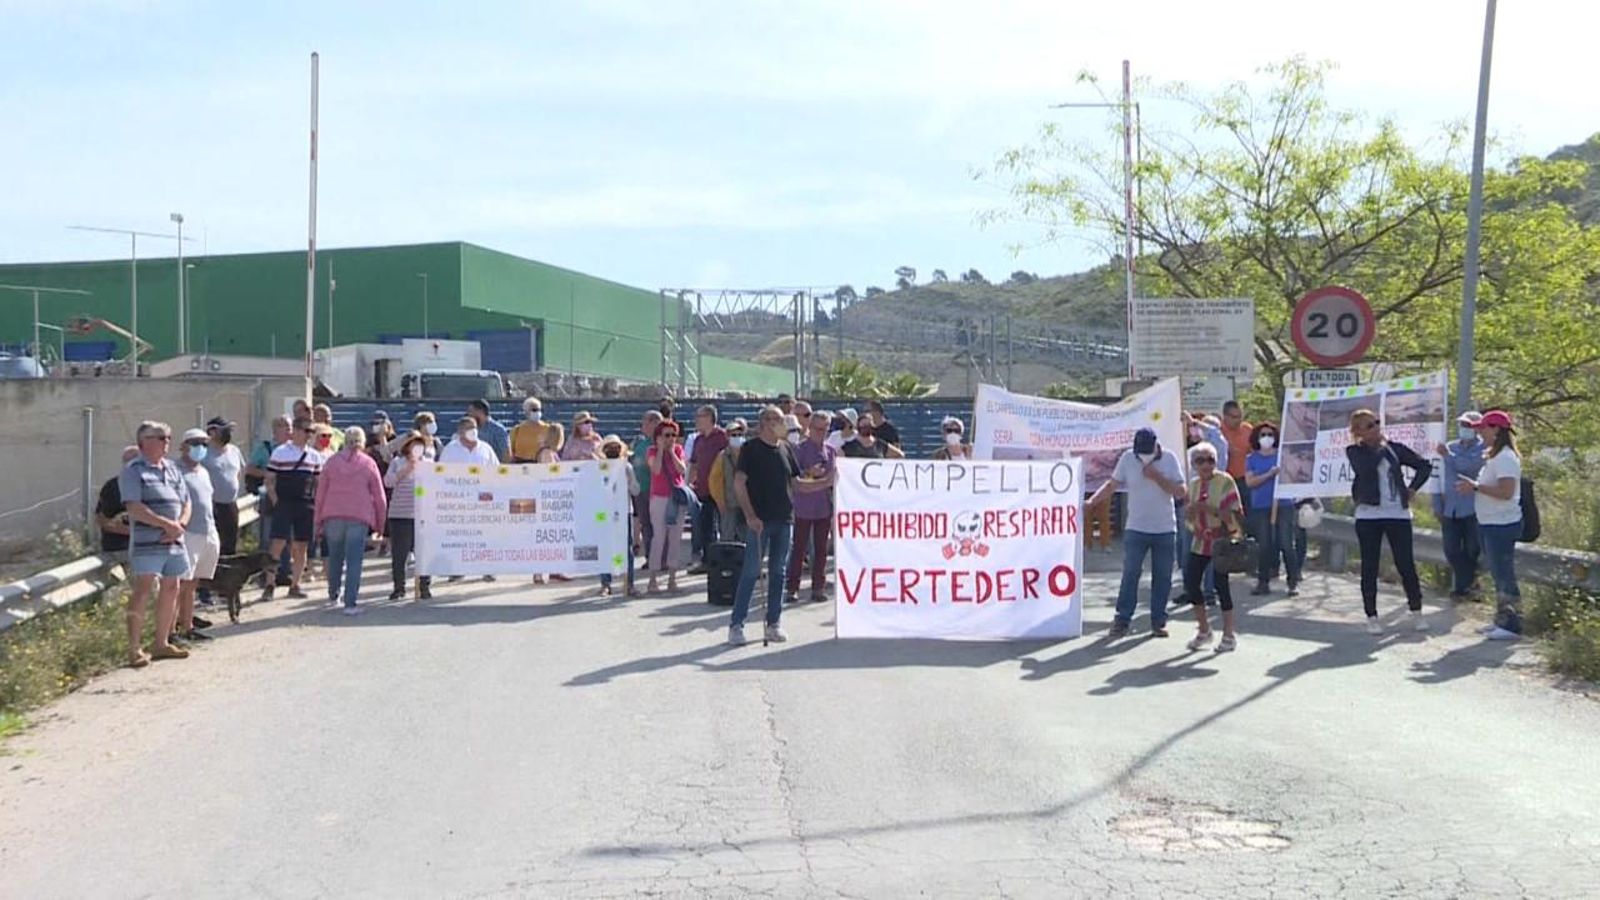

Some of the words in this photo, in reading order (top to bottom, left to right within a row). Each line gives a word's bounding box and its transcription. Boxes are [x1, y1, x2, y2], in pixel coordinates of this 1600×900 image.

[1307, 312, 1358, 338] 20
[1309, 373, 1322, 381] EN
[1326, 373, 1352, 381] TODA
[861, 461, 1074, 494] CAMPELLO
[1319, 463, 1332, 484] SI
[541, 489, 574, 499] BASURA
[541, 501, 574, 510] BASURA
[541, 512, 575, 522] BASURA
[837, 510, 948, 539] PROHIBIDO
[983, 504, 1078, 538] RESPIRAR
[536, 528, 576, 543] BASURA
[462, 549, 469, 561] EL
[470, 549, 503, 561] CAMPELLO
[838, 564, 1077, 604] VERTEDERO
